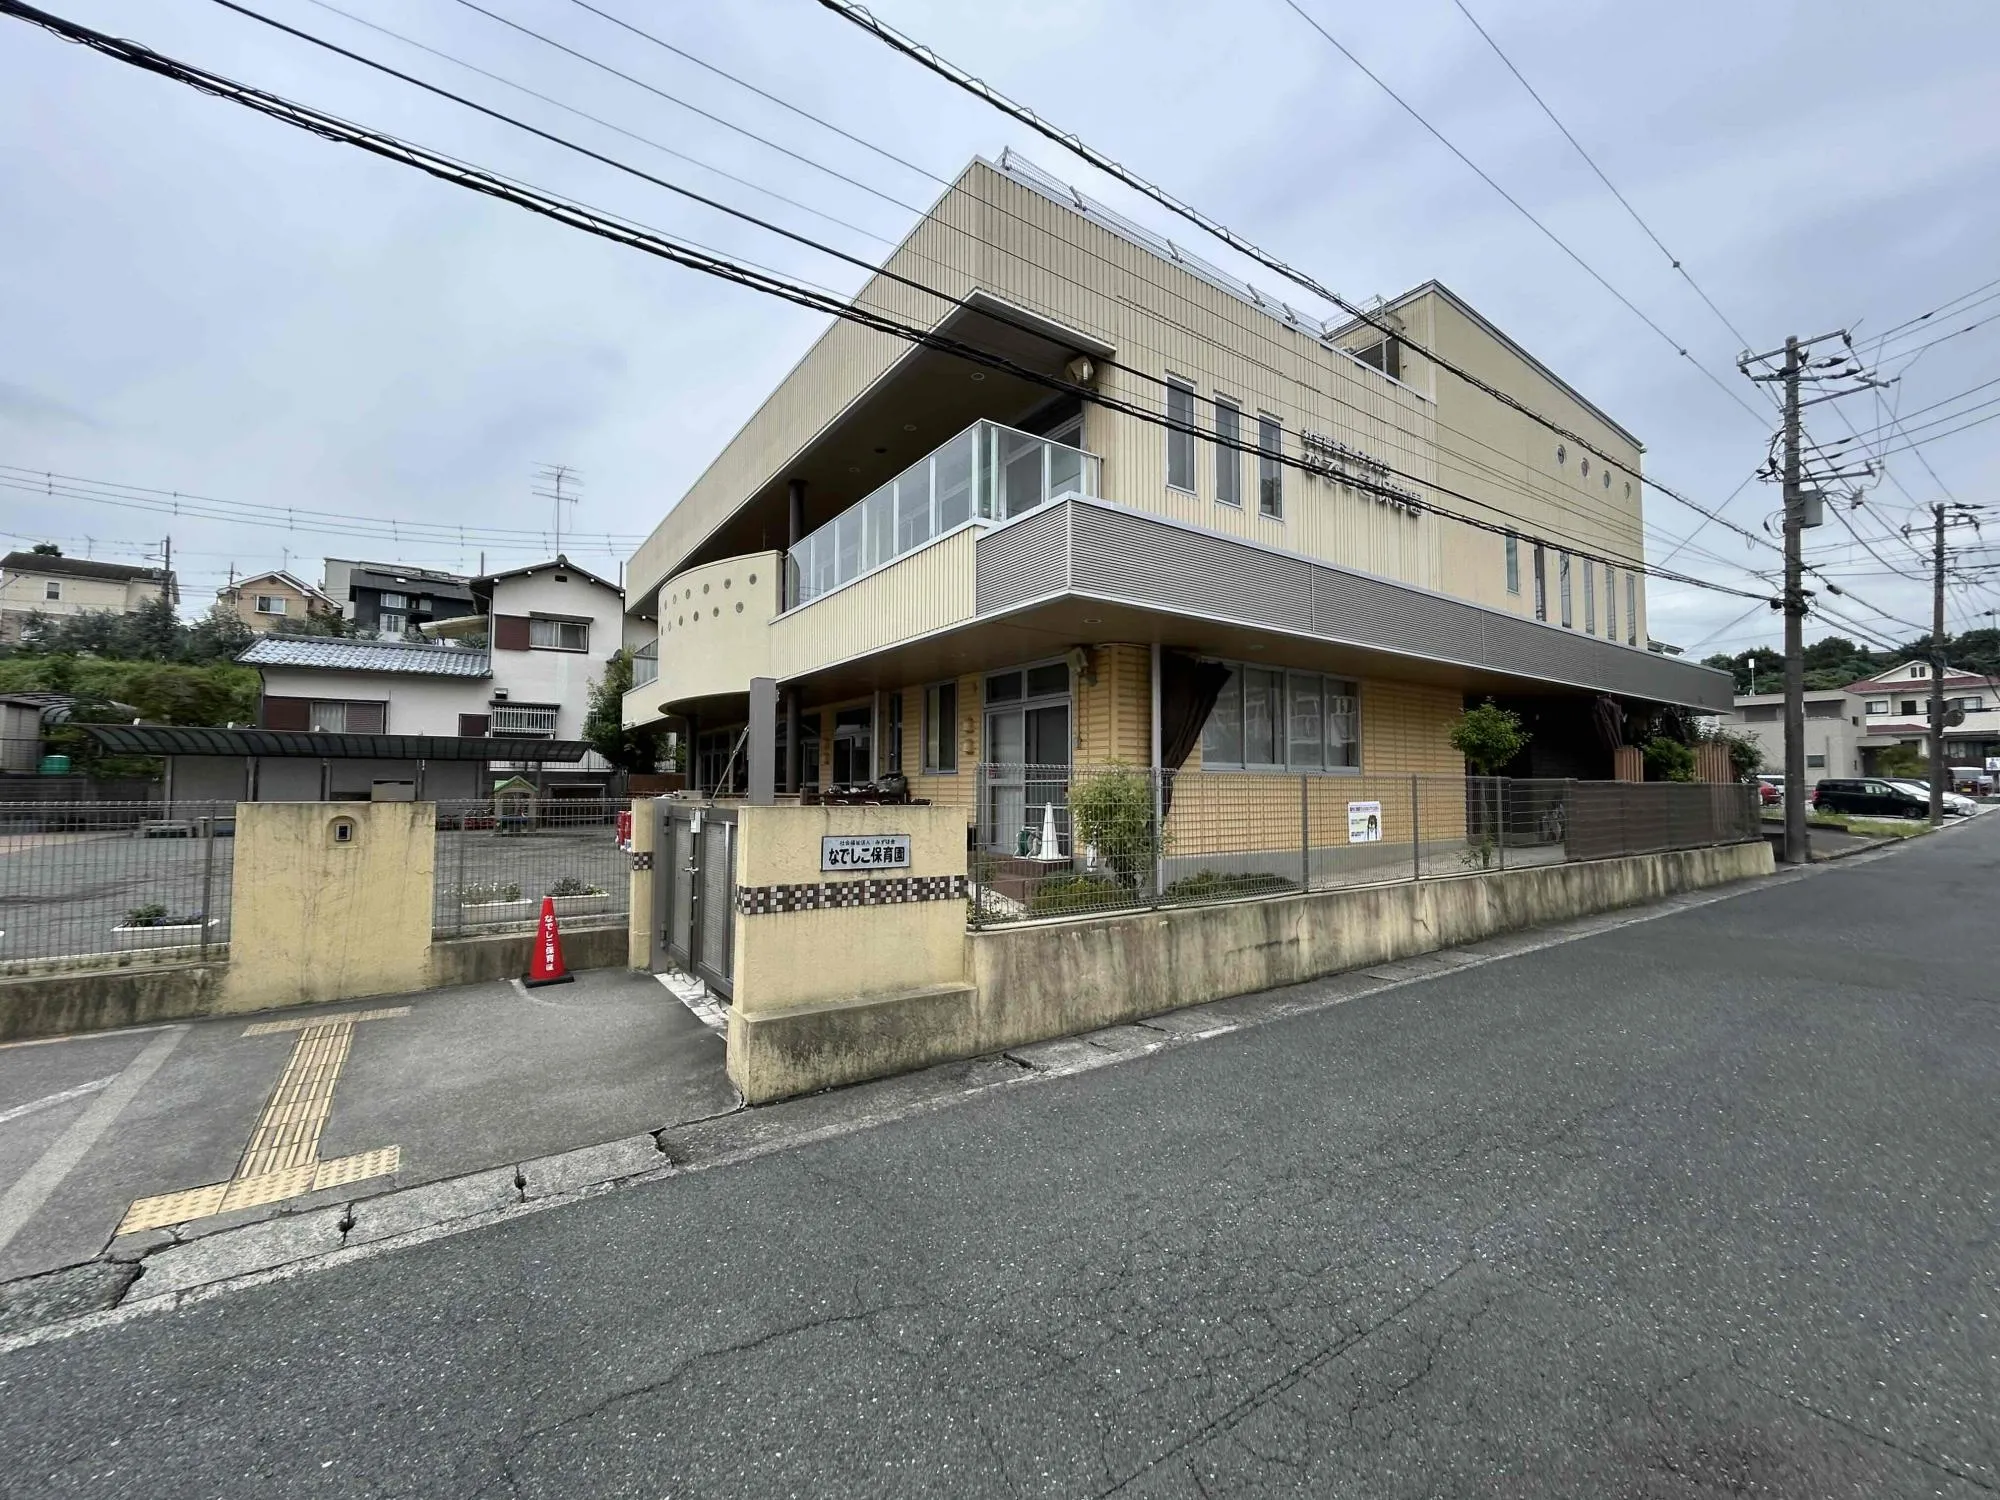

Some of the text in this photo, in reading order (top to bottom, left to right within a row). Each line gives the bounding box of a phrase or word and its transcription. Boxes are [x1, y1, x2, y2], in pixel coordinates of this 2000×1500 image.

[829, 846, 905, 865] なでしこ保育園
